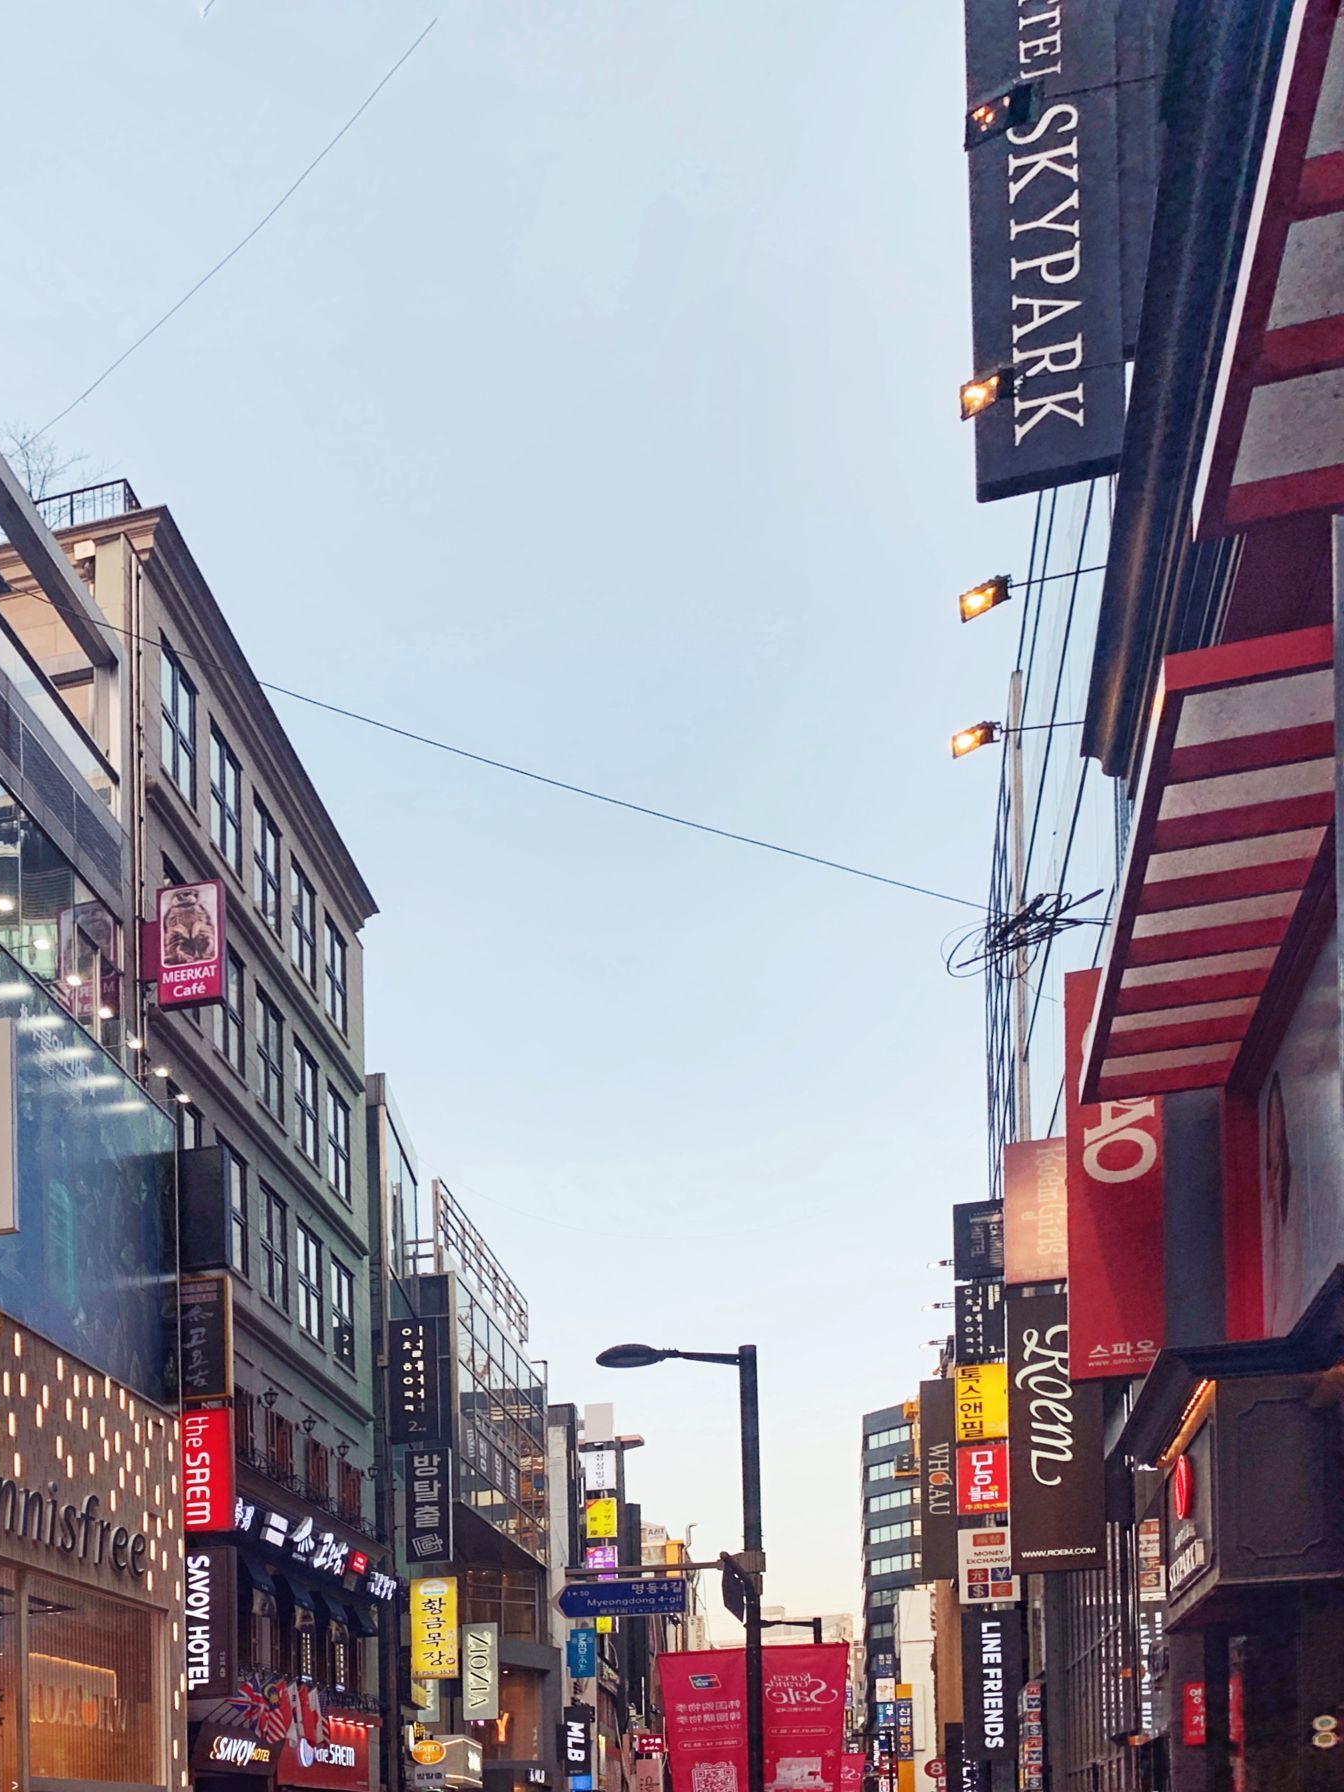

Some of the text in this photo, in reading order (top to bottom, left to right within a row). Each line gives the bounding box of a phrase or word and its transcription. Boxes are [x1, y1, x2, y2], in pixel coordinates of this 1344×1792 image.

[1007, 103, 1085, 447] SKYPARK
[162, 965, 217, 984] MEERKAT
[173, 984, 206, 998] Café
[1088, 1340, 1156, 1358] 스파오
[959, 1367, 984, 1438] 톡스앤필
[1015, 1324, 1073, 1486] Roem
[185, 1416, 211, 1525] the SAEM
[413, 1454, 440, 1528] 방탈출
[587, 1594, 682, 1607] Myeongdong 4-gil
[631, 1581, 682, 1595] 명동4길
[185, 1555, 210, 1691] SAVOY HOTEL
[421, 1597, 446, 1666] 황금목장
[981, 1622, 1005, 1748] LINE FRIENDS
[216, 1736, 271, 1767] SAVOY HOTEL
[328, 1743, 355, 1767] SAEM
[567, 1721, 585, 1762] MLB
